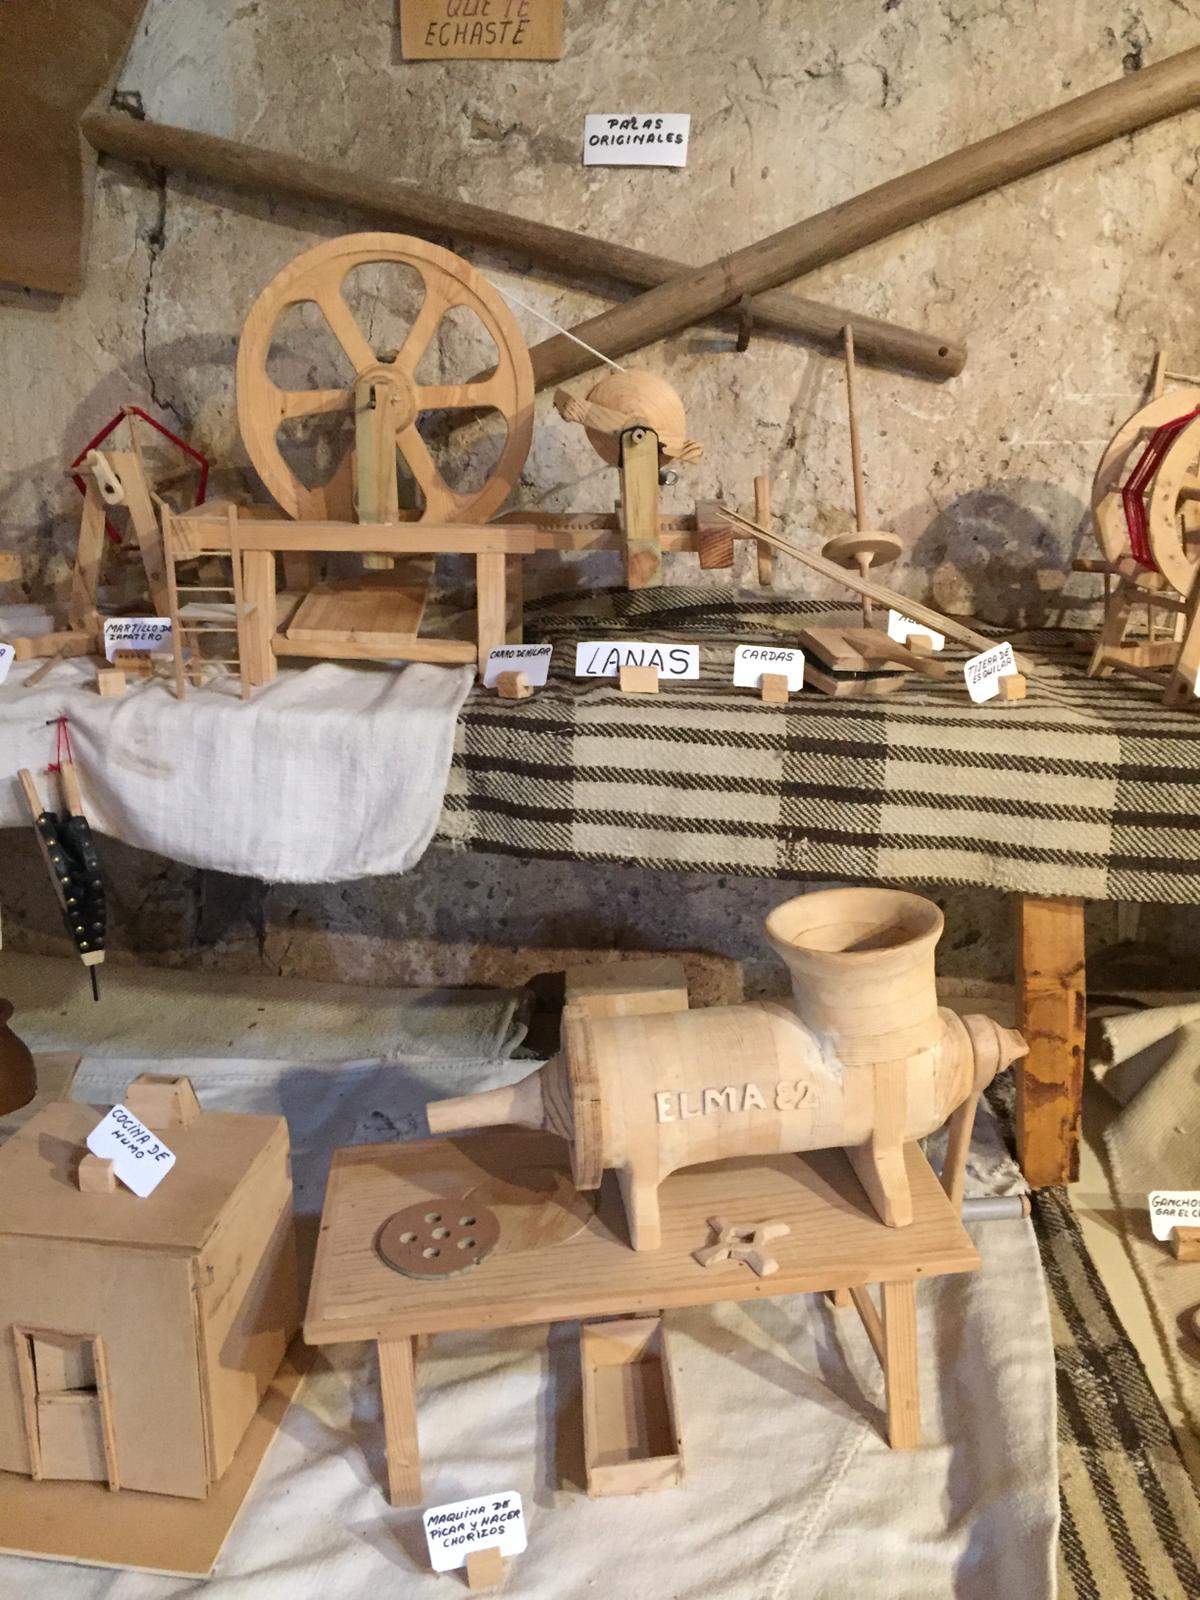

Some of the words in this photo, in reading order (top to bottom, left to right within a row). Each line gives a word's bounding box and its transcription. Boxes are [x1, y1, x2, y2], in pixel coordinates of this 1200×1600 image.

[424, 19, 530, 46] ECHASTE
[607, 116, 663, 130] PALAS
[588, 132, 683, 146] ORIGINALES
[105, 623, 158, 633] MARTILLO
[109, 633, 162, 642] ZAPATERO
[489, 648, 515, 659] CARRO
[741, 649, 795, 662] CARDAS
[998, 647, 1010, 661] DE
[586, 647, 690, 675] LANAS
[655, 1083, 767, 1123] ELMA
[111, 1130, 145, 1159] HUMO
[147, 1144, 171, 1162] DE
[1151, 1195, 1200, 1208] GANCHO
[492, 1499, 511, 1511] DE
[480, 1508, 521, 1527] HACER
[443, 1525, 505, 1548] CHORIZOS
